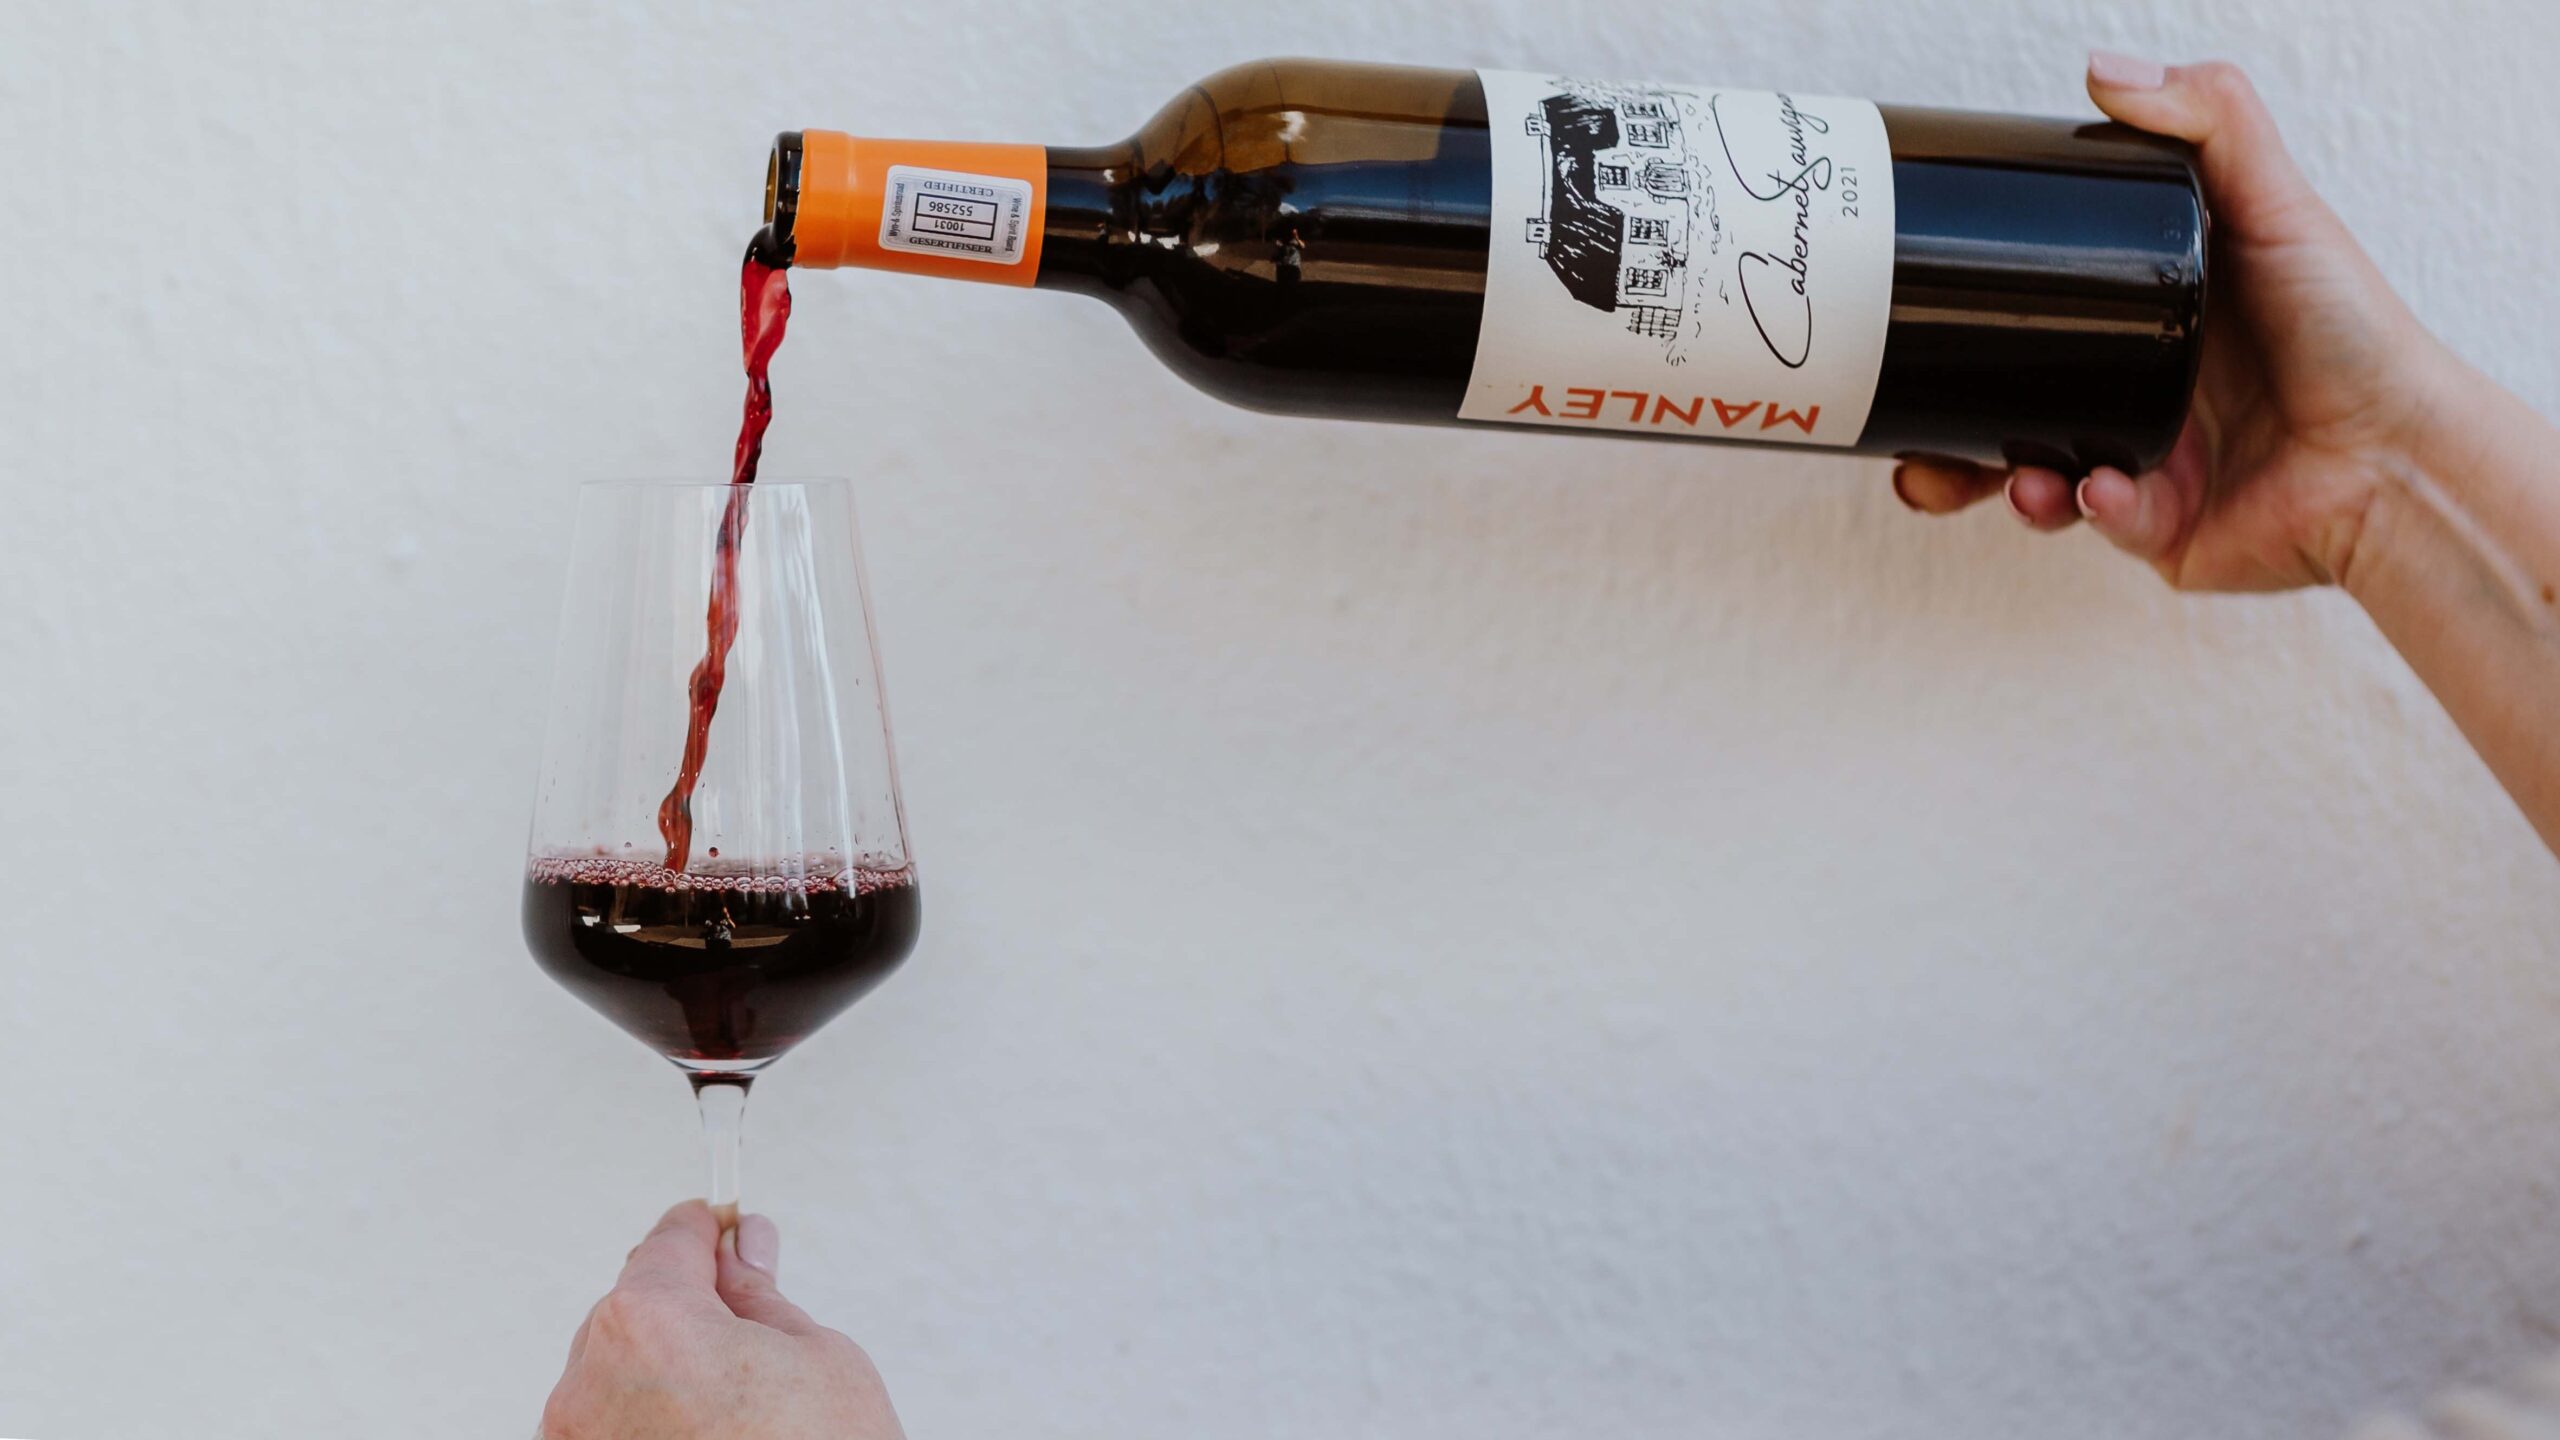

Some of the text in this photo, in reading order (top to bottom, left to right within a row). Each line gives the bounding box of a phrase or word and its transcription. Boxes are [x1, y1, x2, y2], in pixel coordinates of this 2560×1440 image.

[923, 180, 995, 197] CERTIFIED
[1840, 166, 1859, 218] 2021
[928, 200, 974, 217] 552586
[1011, 197, 1023, 212] Wine
[933, 219, 965, 232] 10031
[908, 236, 993, 254] GESERTIFISEER
[1739, 169, 1812, 368] Cabernet
[1506, 384, 1821, 435] MANLEY
